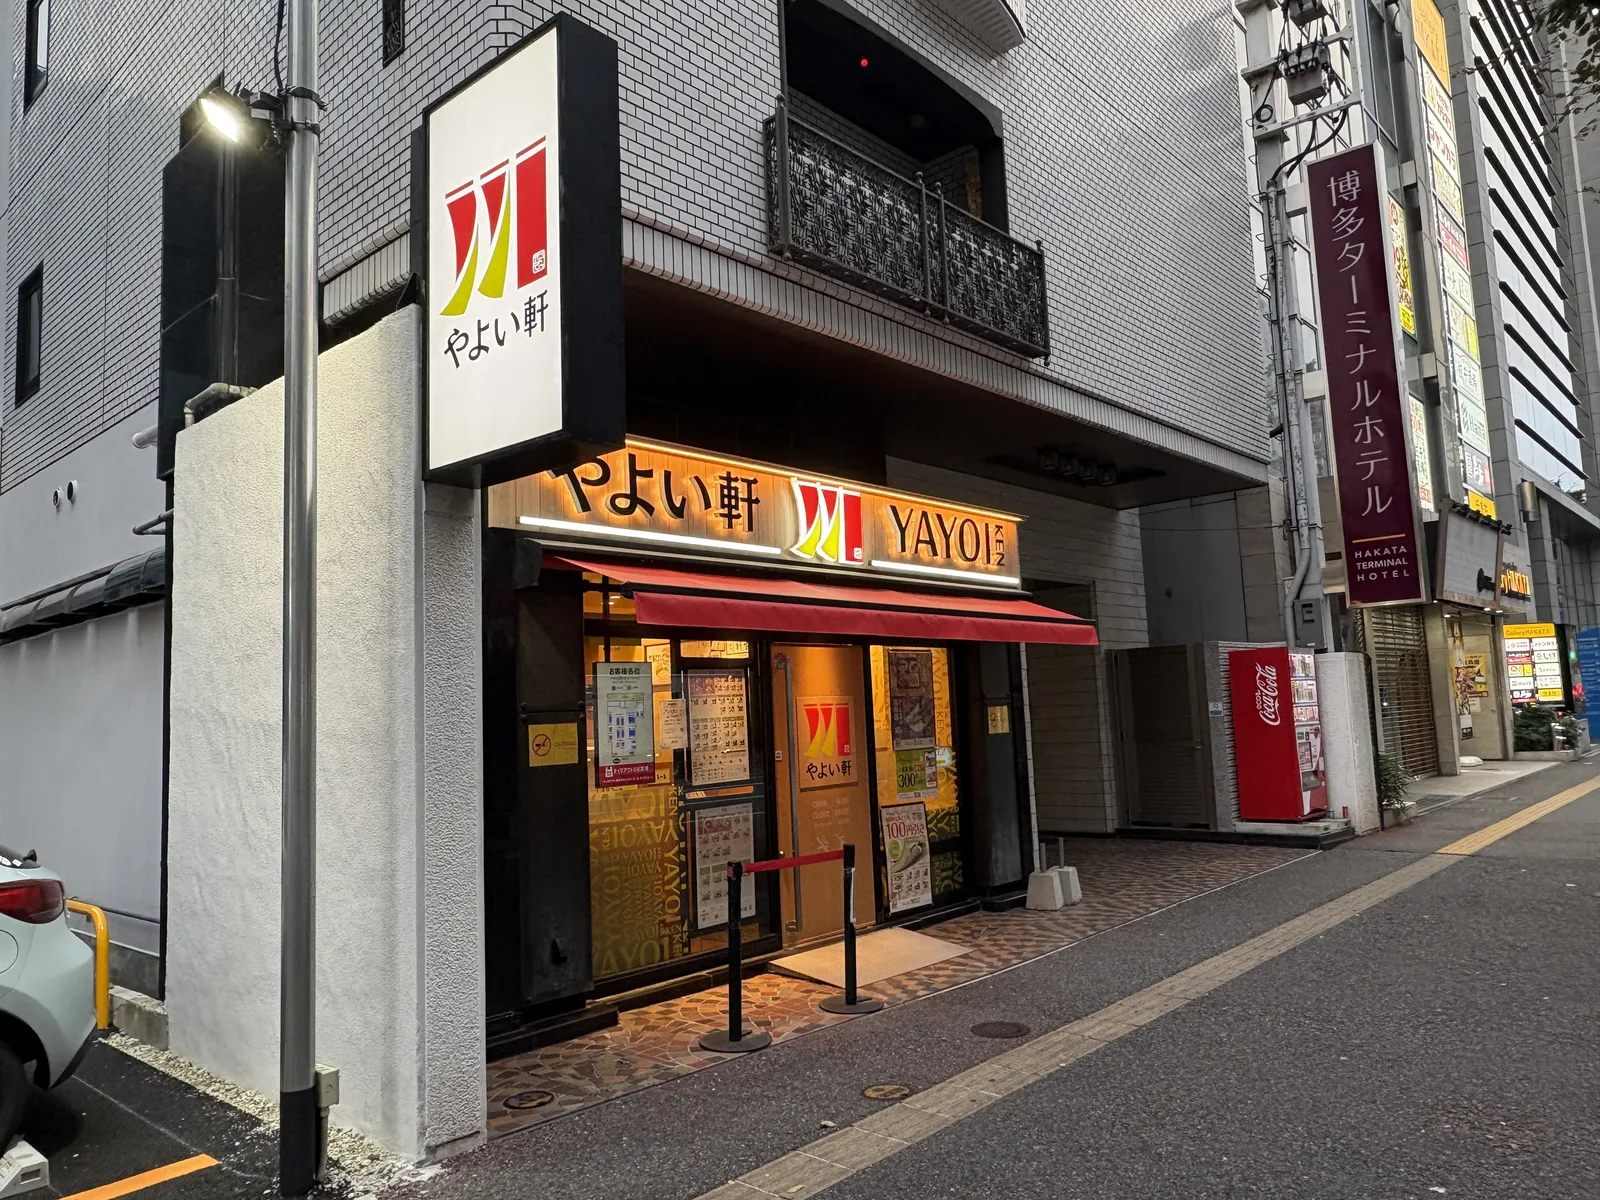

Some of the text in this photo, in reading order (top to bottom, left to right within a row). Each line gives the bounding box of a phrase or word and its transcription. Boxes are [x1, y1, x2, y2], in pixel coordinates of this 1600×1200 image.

[444, 289, 549, 369] やよい軒
[1327, 170, 1393, 517] 博多ターミナルホテル
[549, 452, 761, 532] やよい軒
[887, 504, 1005, 567] YAYOI KEN
[1355, 545, 1408, 559] HAKATA
[1356, 556, 1408, 570] TERMINAL
[1357, 568, 1409, 582] HOTEL
[805, 760, 852, 781] やよい軒
